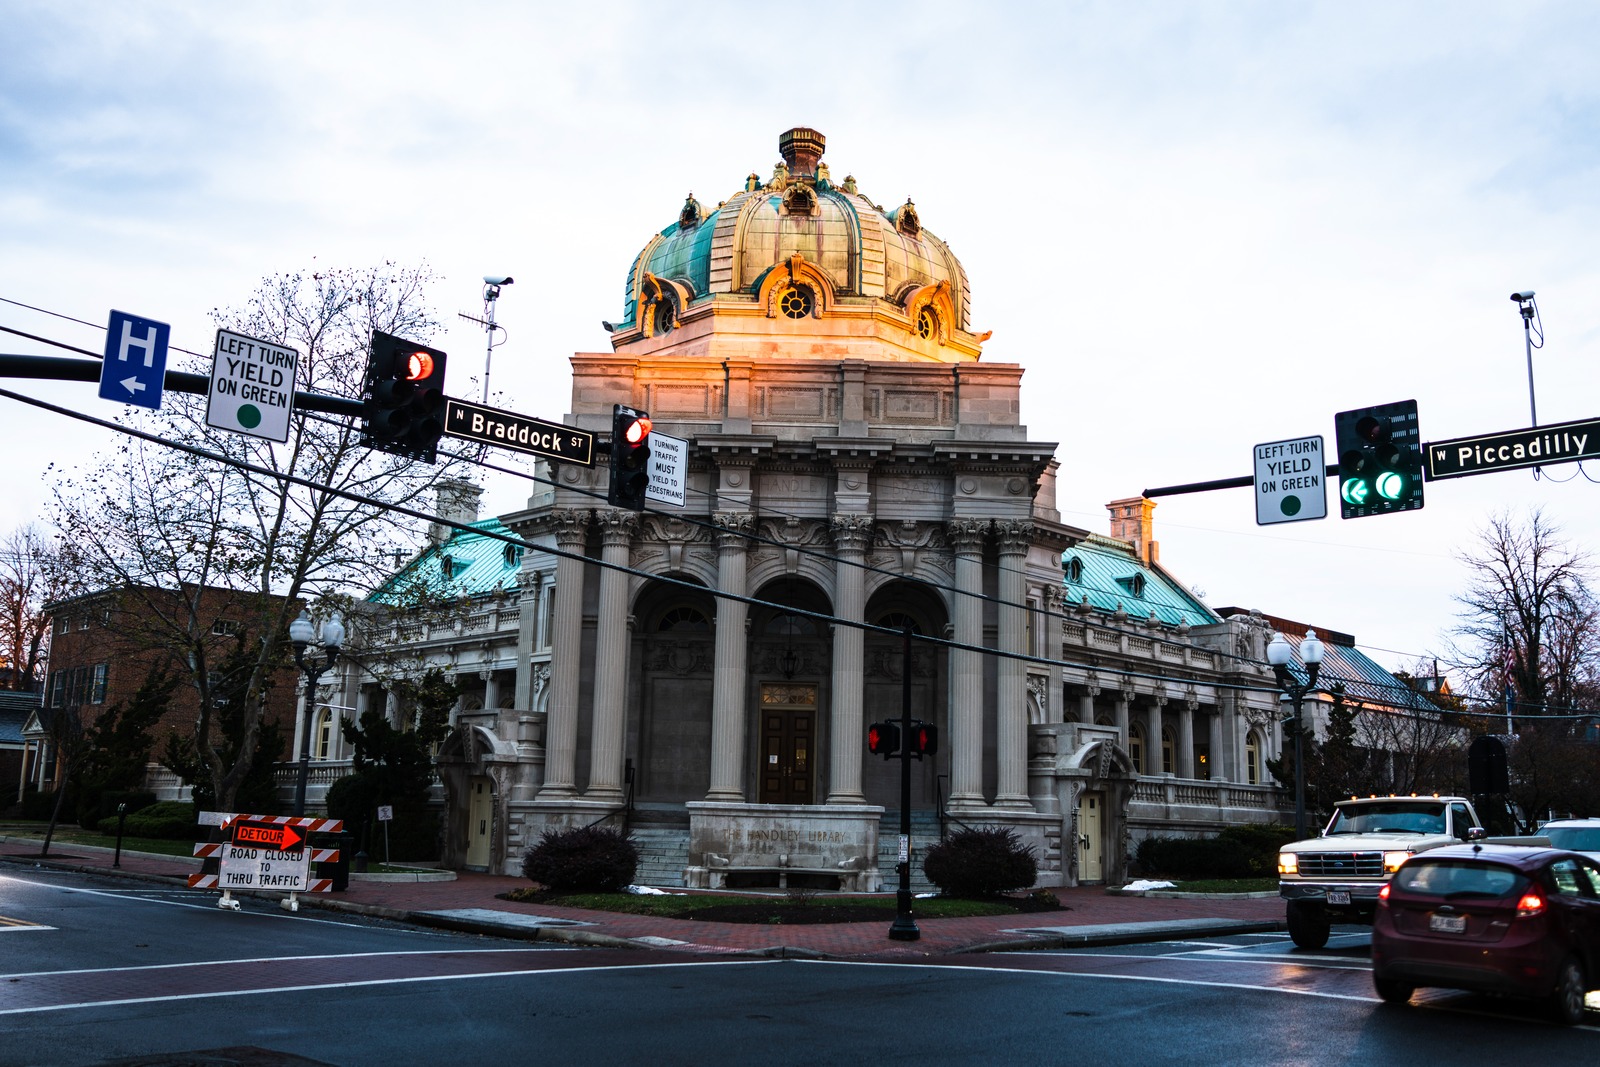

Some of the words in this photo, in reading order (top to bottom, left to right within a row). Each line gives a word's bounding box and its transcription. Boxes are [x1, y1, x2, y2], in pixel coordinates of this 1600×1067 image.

[118, 320, 157, 368] H
[219, 336, 254, 360] LEFT
[258, 347, 295, 370] TURN
[226, 357, 284, 388] YIELD
[217, 377, 237, 397] ON
[241, 384, 288, 409] GREEN
[456, 409, 464, 420] N
[471, 413, 562, 452] Braddock
[571, 436, 583, 448] ST
[654, 439, 679, 453] TURNING
[1258, 446, 1284, 460] LEFT
[1288, 440, 1318, 454] TURN
[1436, 450, 1446, 461] W
[1458, 433, 1588, 467] Piccadilly
[654, 450, 678, 463] TRAFFIC
[655, 462, 675, 475] MUST
[1267, 458, 1311, 476] YIELD
[652, 474, 669, 486] YIELD
[670, 478, 678, 487] TO
[761, 479, 826, 494] HANDLEY
[1261, 481, 1277, 493] ON
[1281, 475, 1319, 491] GREEN
[240, 827, 284, 843] DETOUR
[723, 828, 741, 840] THE
[747, 829, 801, 842] HANDLEY
[808, 830, 847, 843] LIBRARY
[229, 848, 258, 859] ROAD
[264, 849, 303, 862] CLOSED
[260, 862, 271, 872] TO
[226, 873, 253, 885] THRU
[258, 874, 300, 886] TRAFFIC
